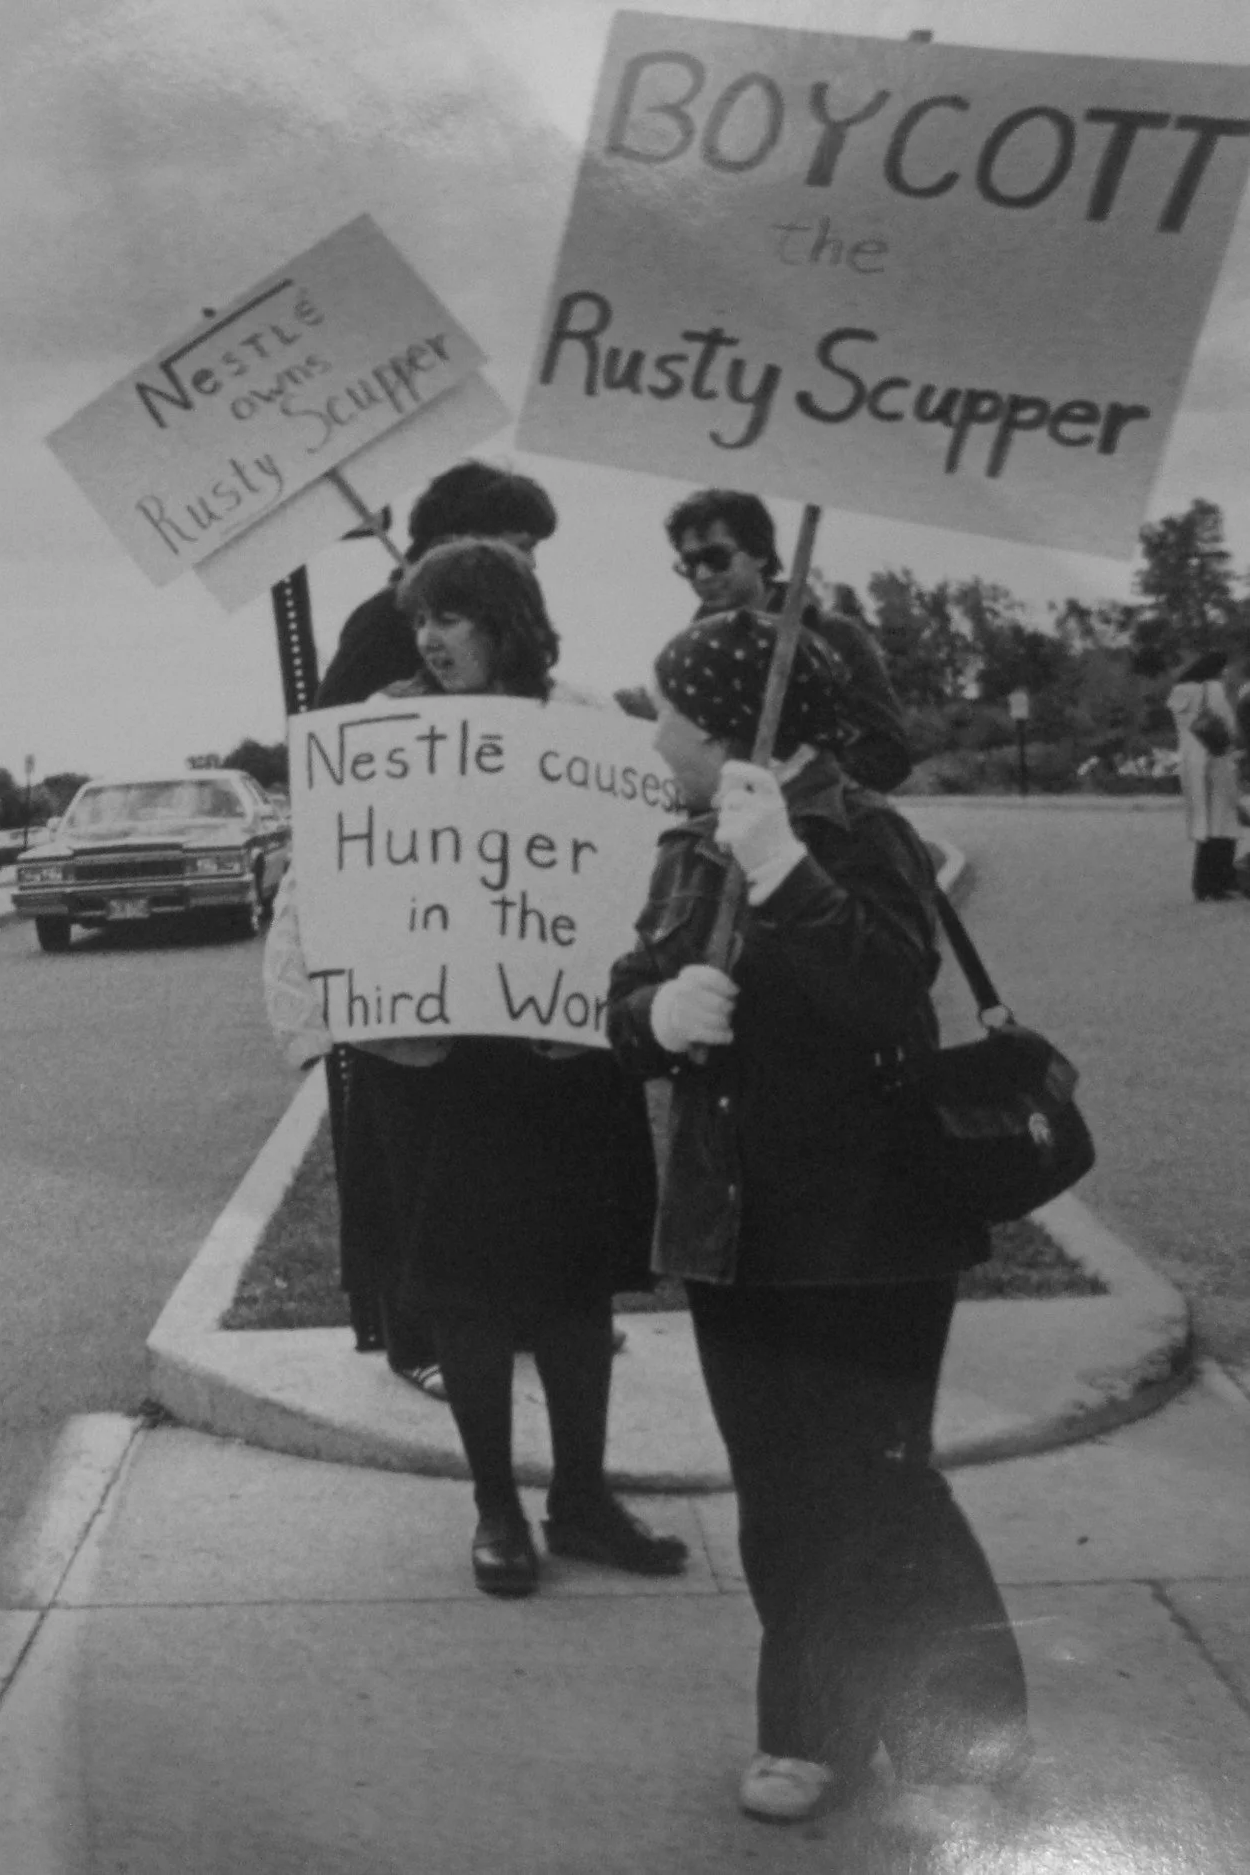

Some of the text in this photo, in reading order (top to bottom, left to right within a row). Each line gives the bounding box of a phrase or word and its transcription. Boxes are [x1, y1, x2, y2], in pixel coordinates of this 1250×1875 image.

[604, 50, 1250, 233] BOYCOTT
[772, 215, 889, 274] the
[230, 353, 333, 421] owns
[280, 333, 450, 454] Scupper
[540, 291, 1151, 479] Rusty Scupper
[336, 805, 598, 891] Hunger
[409, 891, 577, 946] in the
[308, 964, 452, 1028] Third
